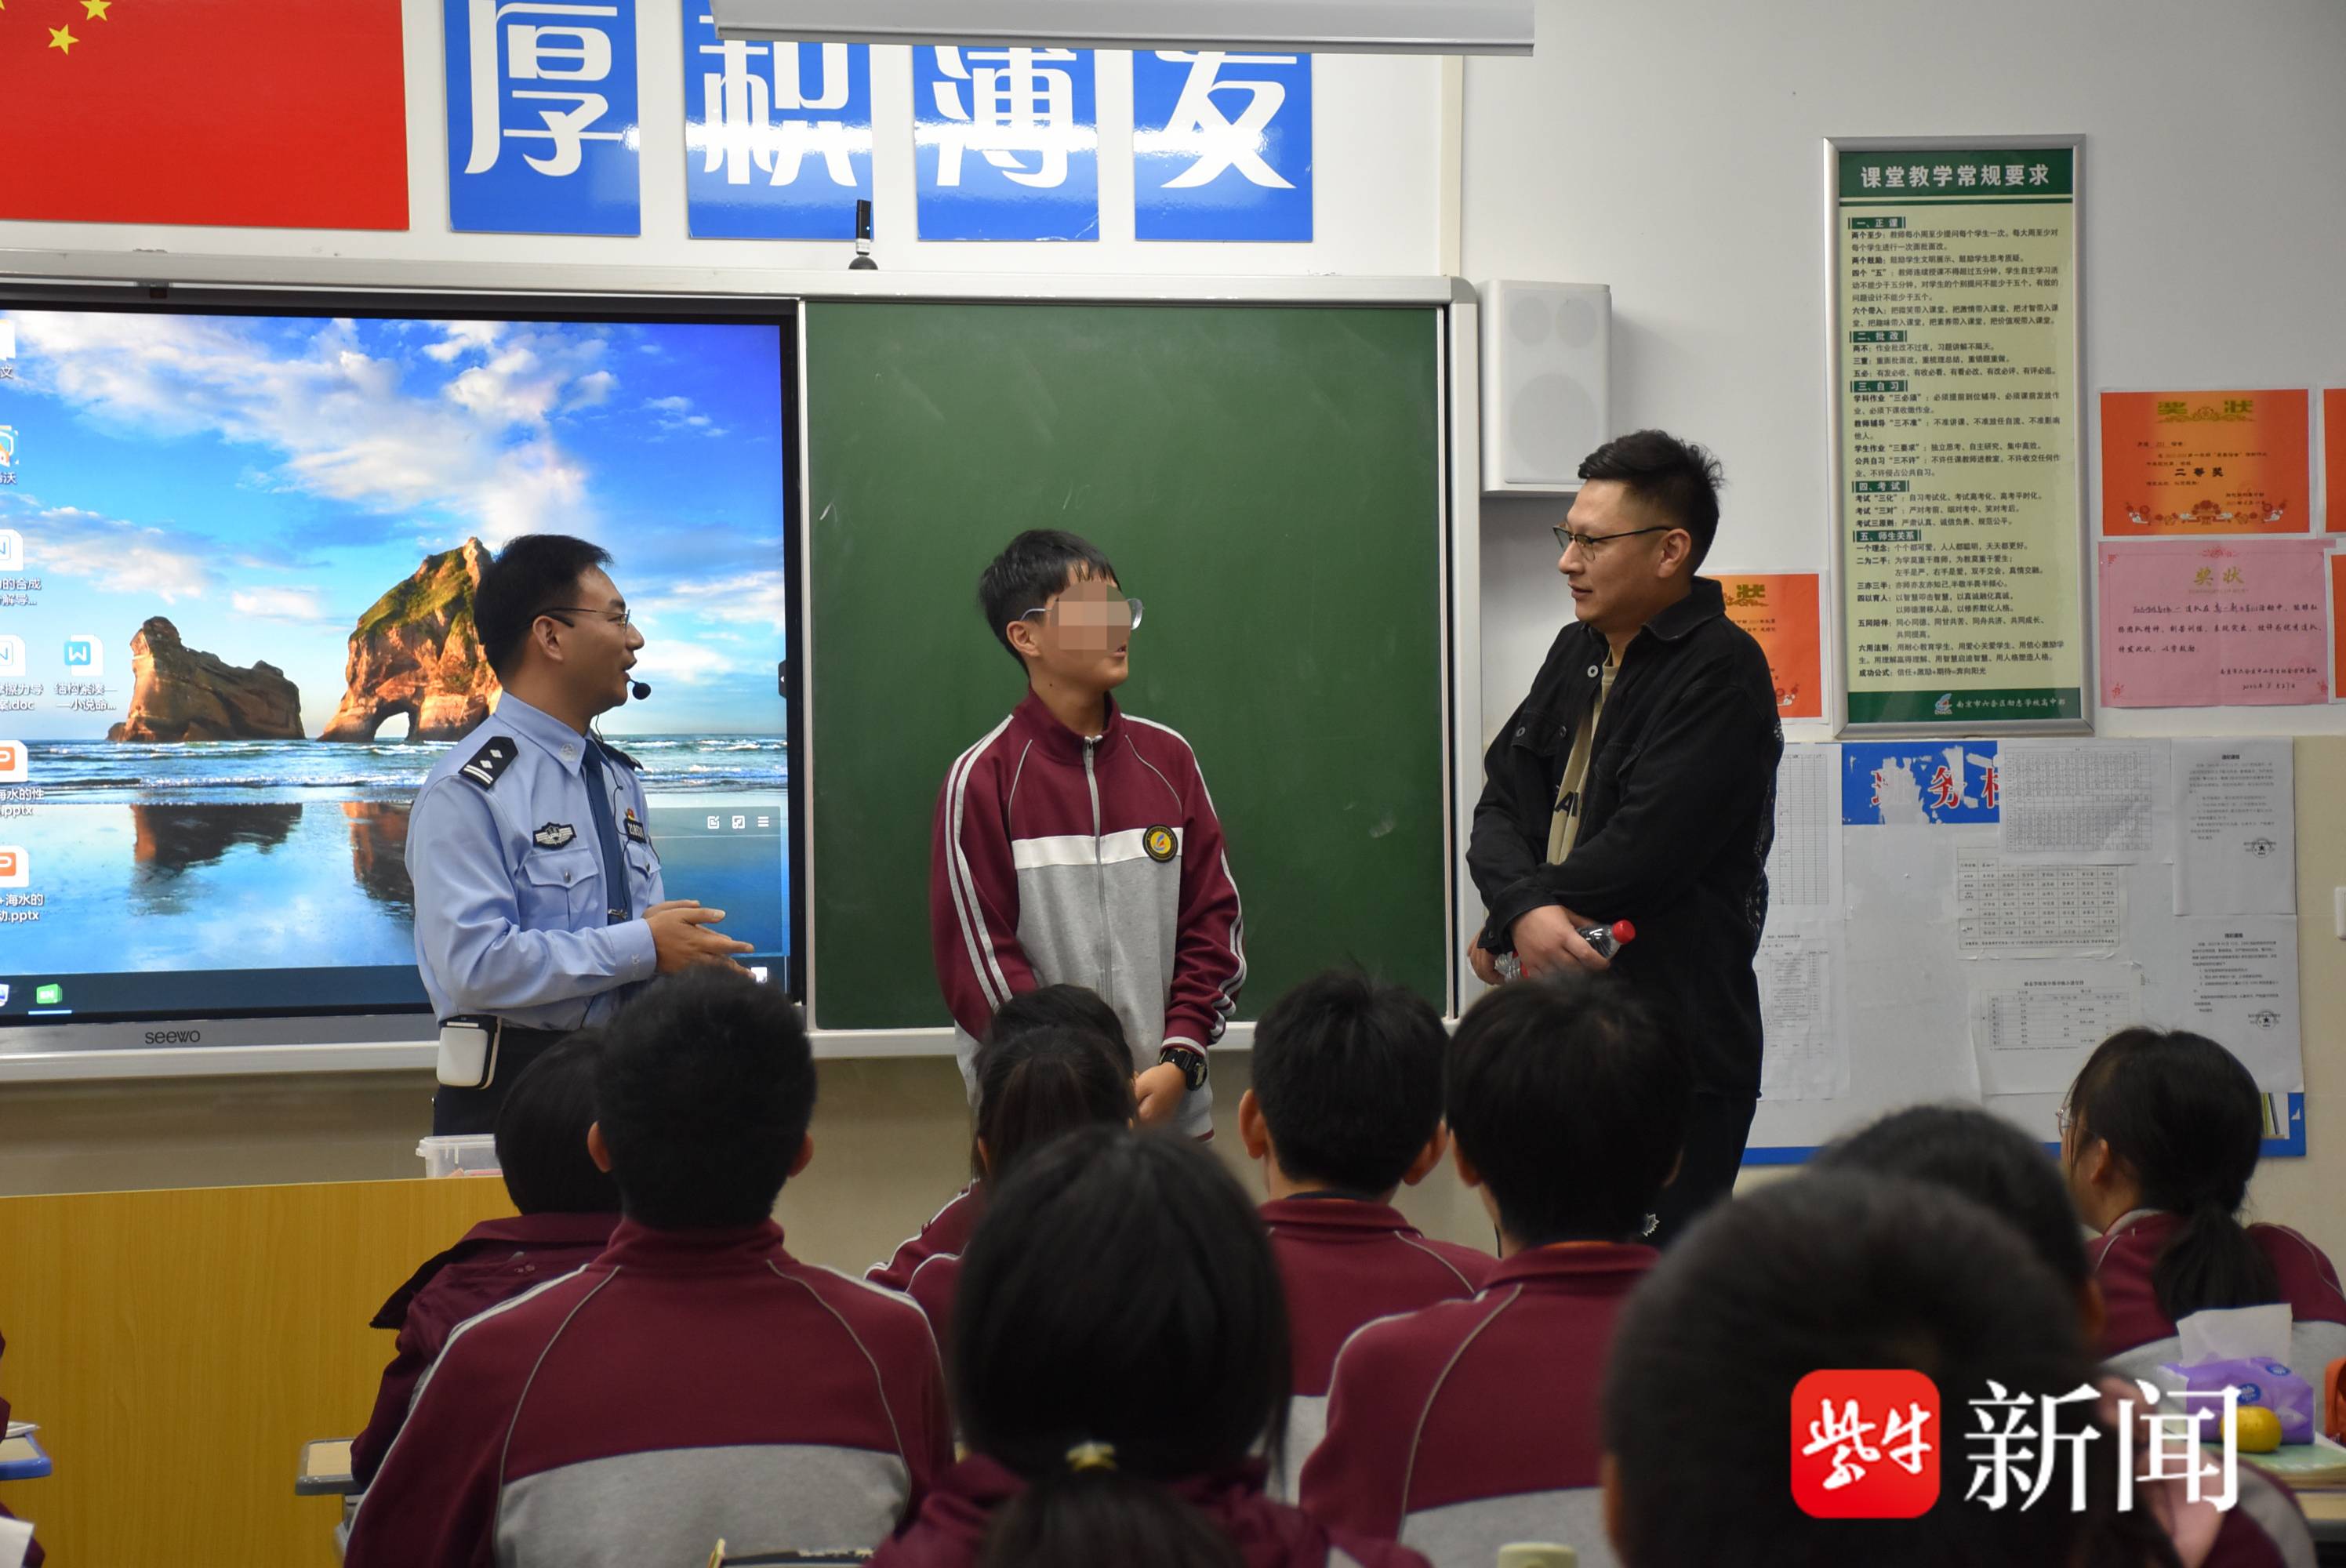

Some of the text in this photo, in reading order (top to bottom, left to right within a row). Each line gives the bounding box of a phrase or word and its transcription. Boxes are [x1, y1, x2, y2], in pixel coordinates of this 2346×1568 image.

[1861, 164, 2050, 188] 课堂教学常规要求
[1858, 382, 1899, 391] 三、自习
[2174, 466, 2224, 477] 二等奖
[0, 472, 16, 484] 沃
[1859, 481, 1901, 491] 四、考试
[1860, 532, 1915, 541] 五、师生关系
[2193, 566, 2245, 586] 奖状
[0, 577, 42, 590] 的合成
[145, 1029, 201, 1045] seewo
